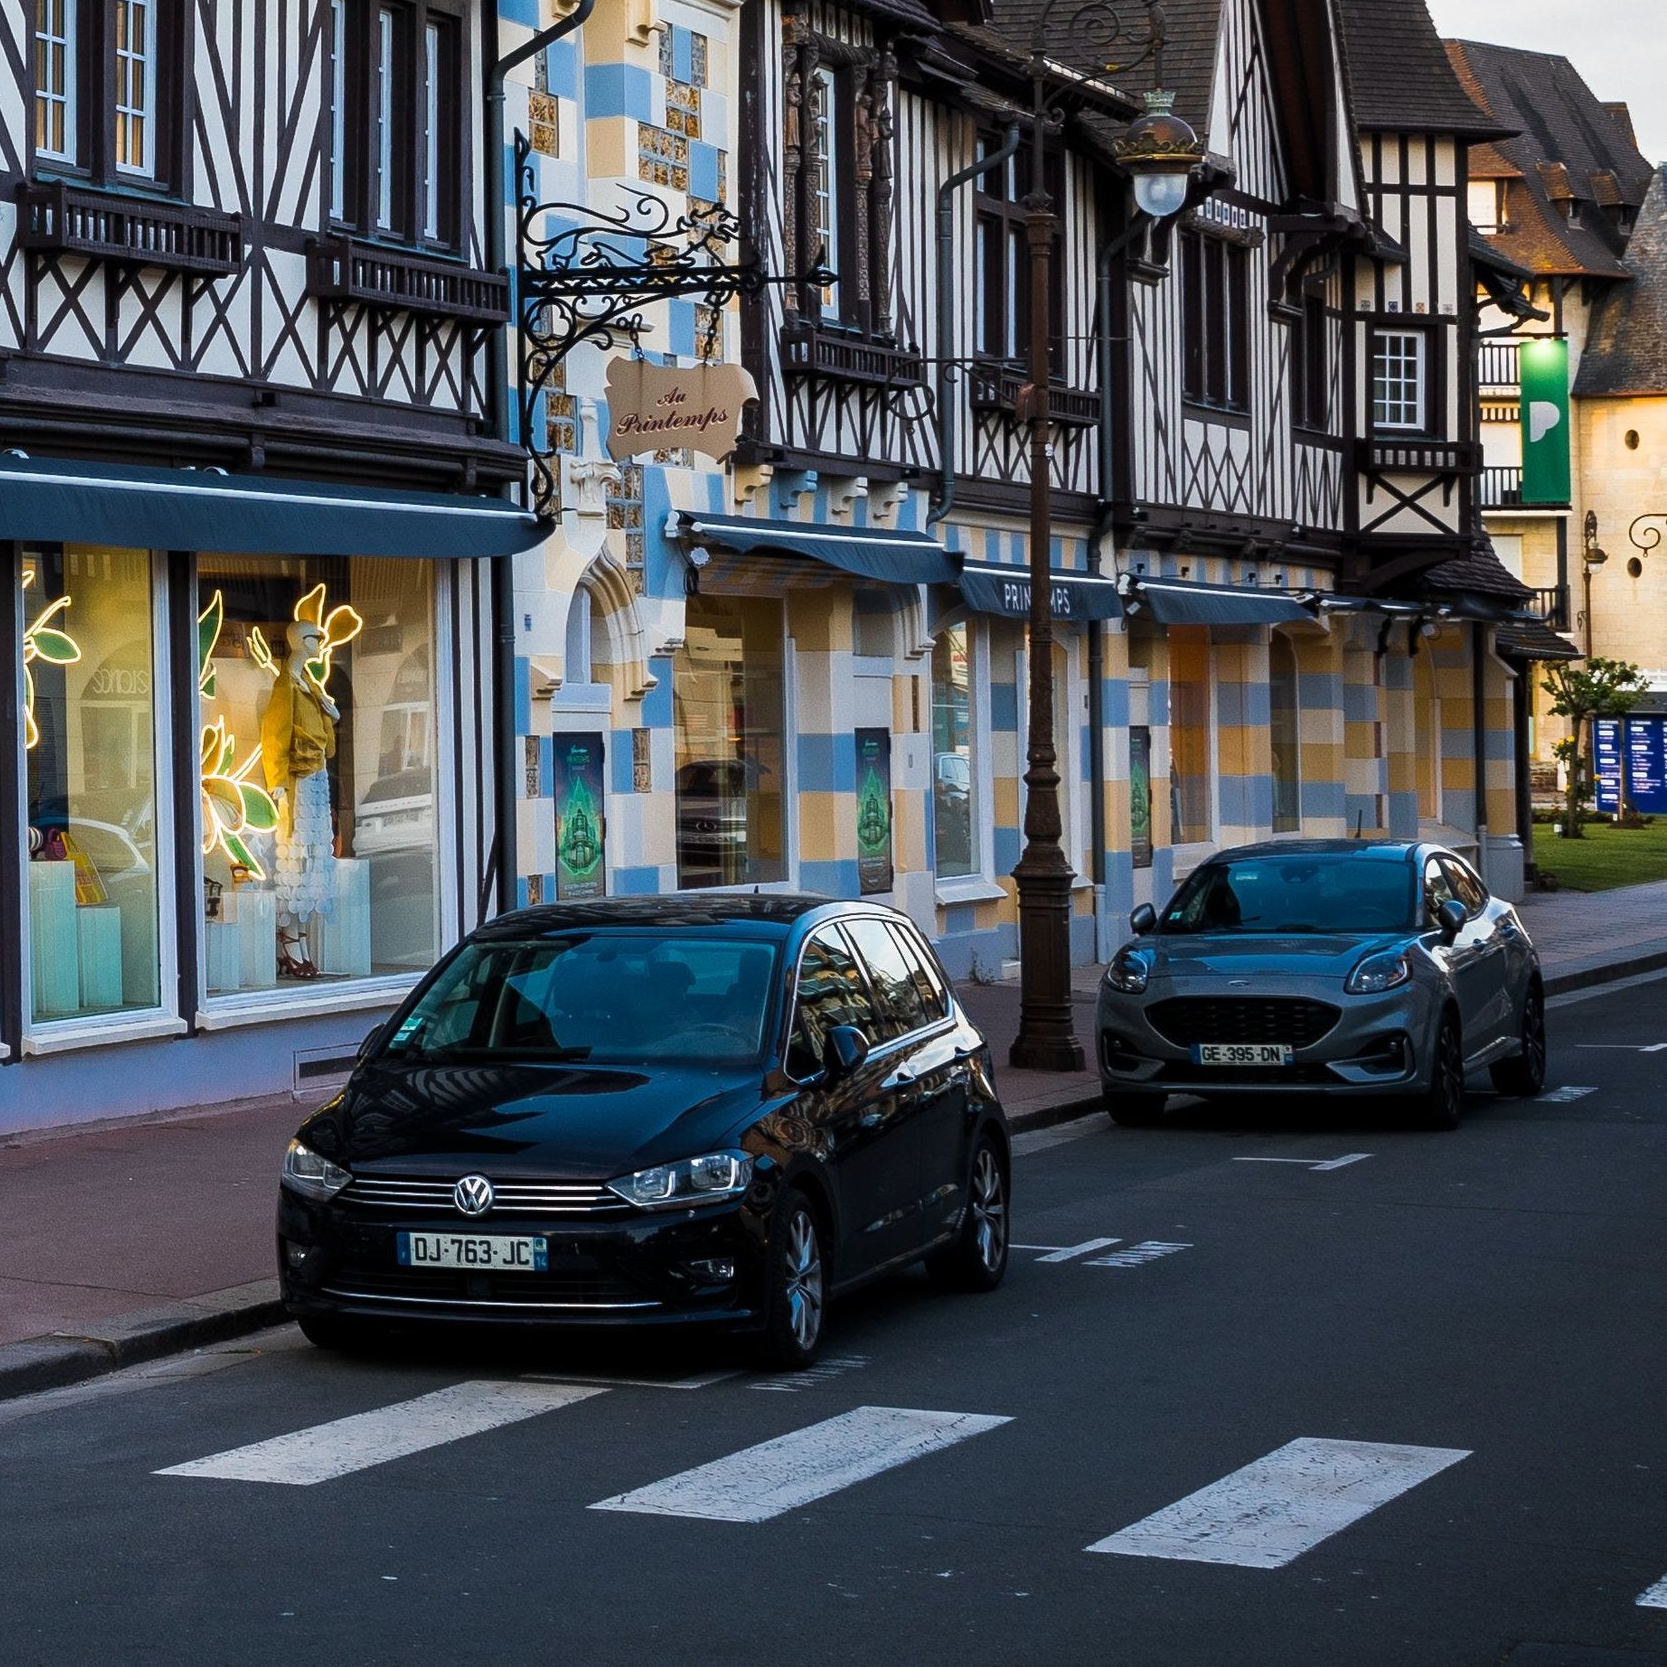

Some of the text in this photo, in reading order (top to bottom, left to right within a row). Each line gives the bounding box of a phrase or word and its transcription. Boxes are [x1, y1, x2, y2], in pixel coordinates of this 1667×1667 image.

[657, 387, 686, 406] Au
[616, 407, 728, 436] Printemps
[1201, 1046, 1281, 1062] GE-395-DN
[414, 1237, 530, 1265] DJ-763-JC
